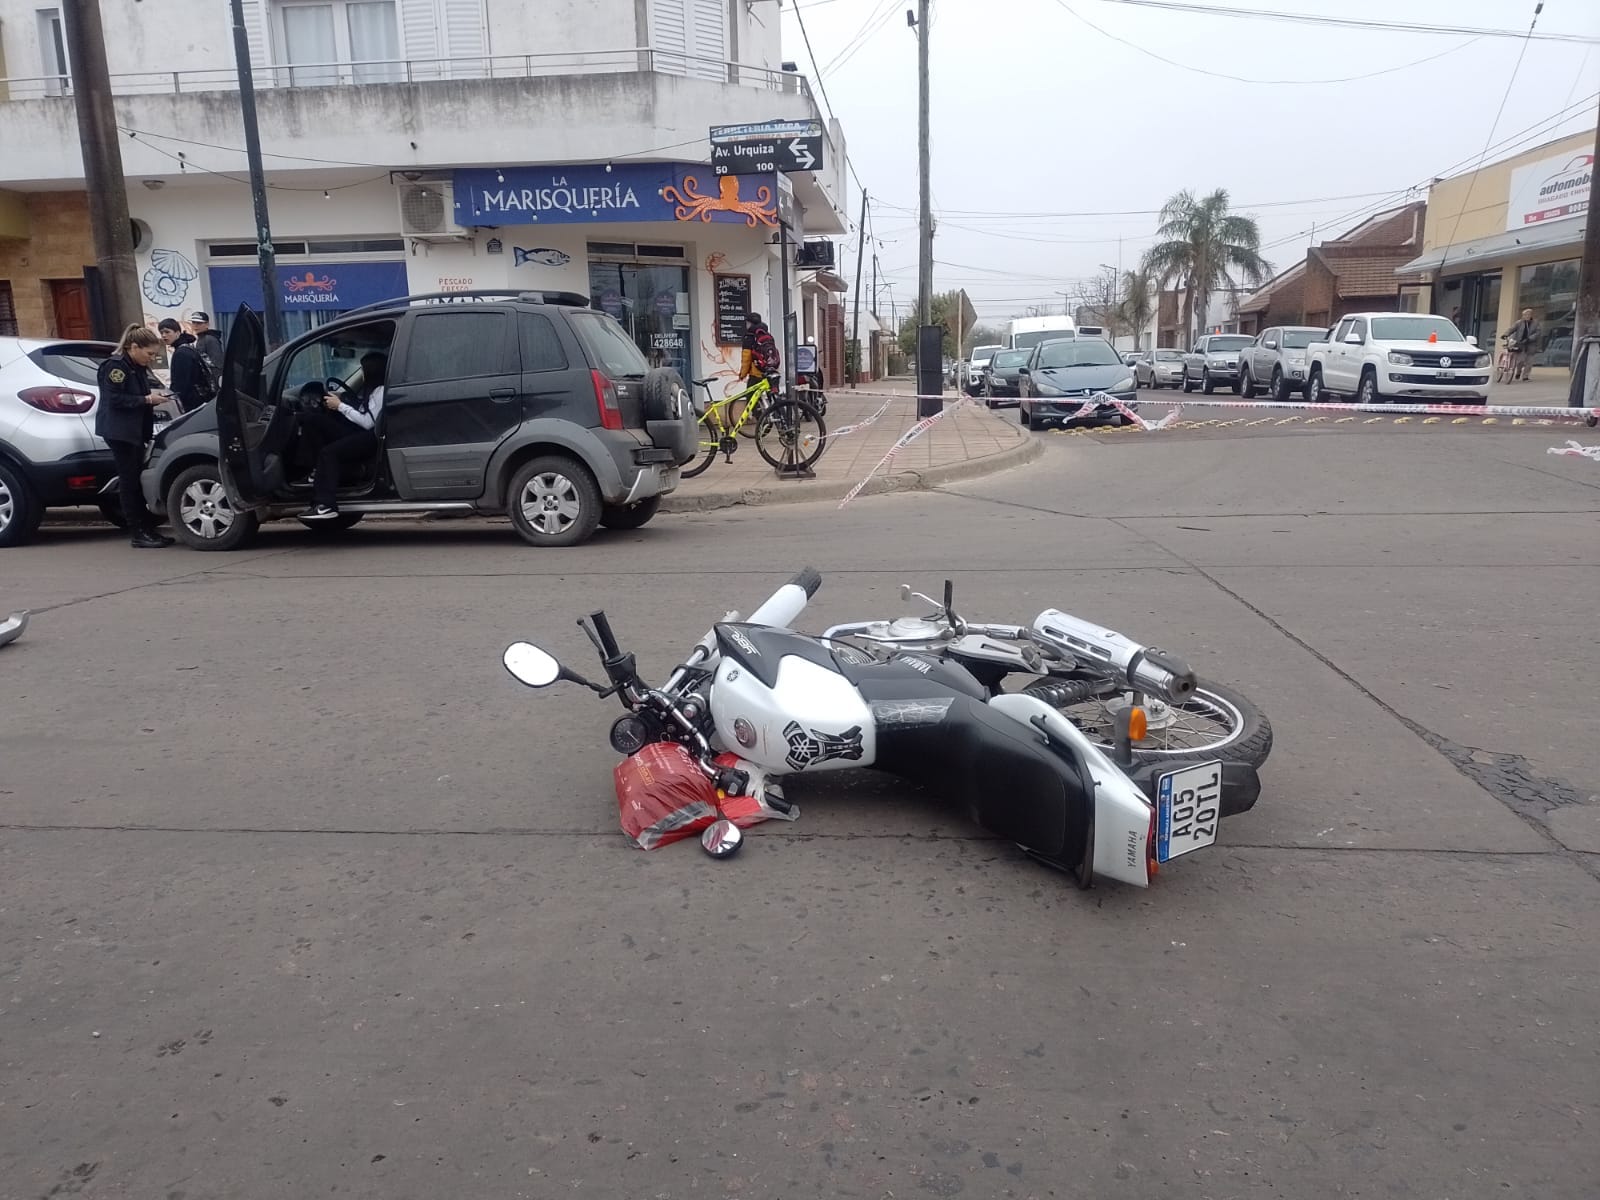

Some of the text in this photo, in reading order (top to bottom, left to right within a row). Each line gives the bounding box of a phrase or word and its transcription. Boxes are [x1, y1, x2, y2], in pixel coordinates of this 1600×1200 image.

[715, 143, 774, 158] Av. Urquiza
[715, 162, 774, 175] 50 100
[552, 177, 568, 187] LA
[1539, 172, 1592, 196] automob
[483, 182, 640, 213] MARISQUERÍA
[654, 339, 683, 348] 428648
[899, 656, 932, 674] YAMAHA
[1172, 789, 1195, 838] A05
[1193, 773, 1219, 841] 20TL
[1128, 830, 1138, 868] YAMAHA
